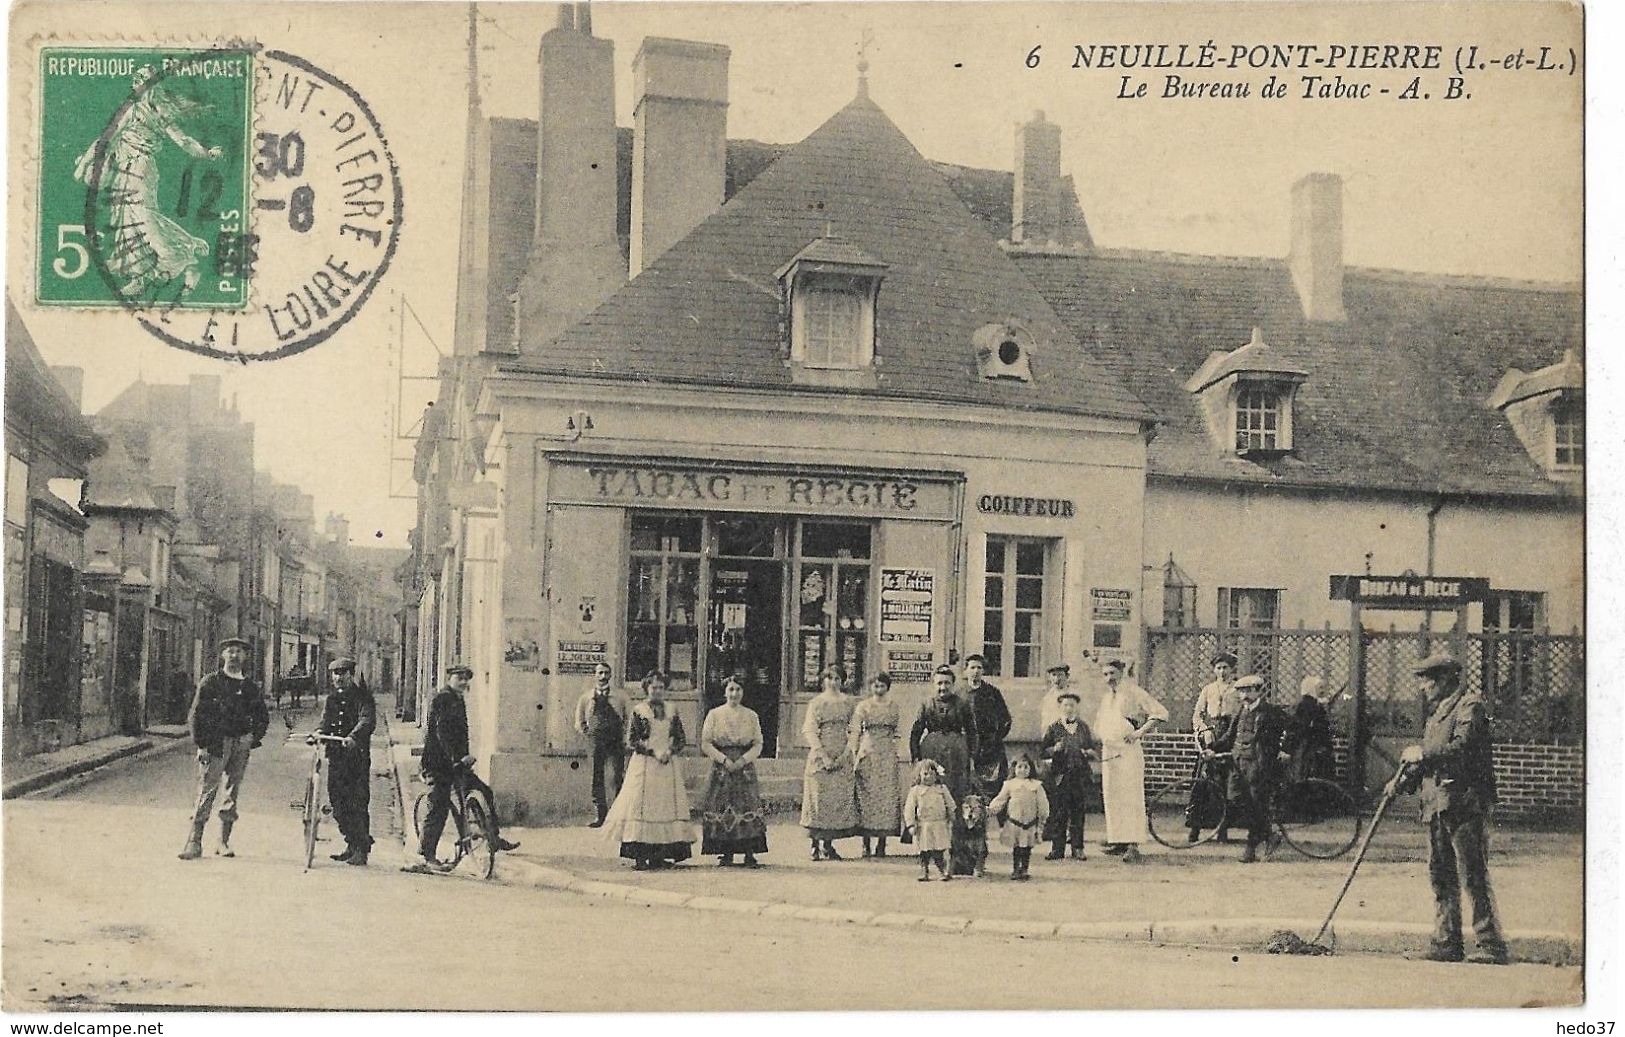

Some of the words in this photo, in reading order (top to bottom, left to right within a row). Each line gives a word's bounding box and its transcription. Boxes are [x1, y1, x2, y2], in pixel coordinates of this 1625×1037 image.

[264, 254, 371, 341] LOIRE
[589, 468, 731, 501] TABAC
[979, 494, 1074, 518] COIFFEUR
